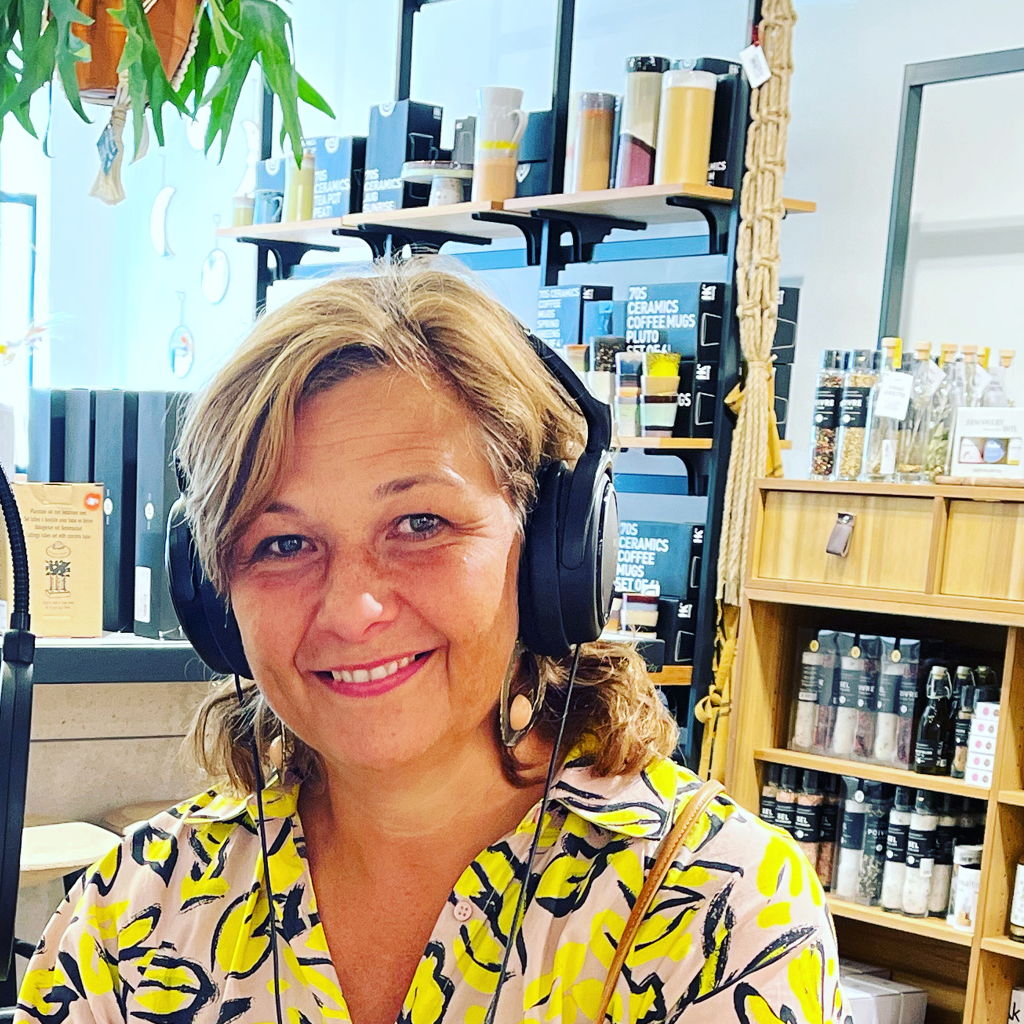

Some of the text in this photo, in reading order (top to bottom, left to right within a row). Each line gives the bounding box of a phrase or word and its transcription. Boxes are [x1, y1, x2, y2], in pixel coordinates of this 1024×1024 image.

[629, 286, 647, 300] 70S
[627, 300, 679, 314] CERAMICS
[626, 314, 695, 329] COFFEE MUGS
[626, 329, 659, 343] PLUTO
[620, 523, 638, 535] 70S
[619, 537, 669, 552] CERAMICS
[617, 550, 656, 565] COFFEE
[616, 563, 645, 578] MUGS
